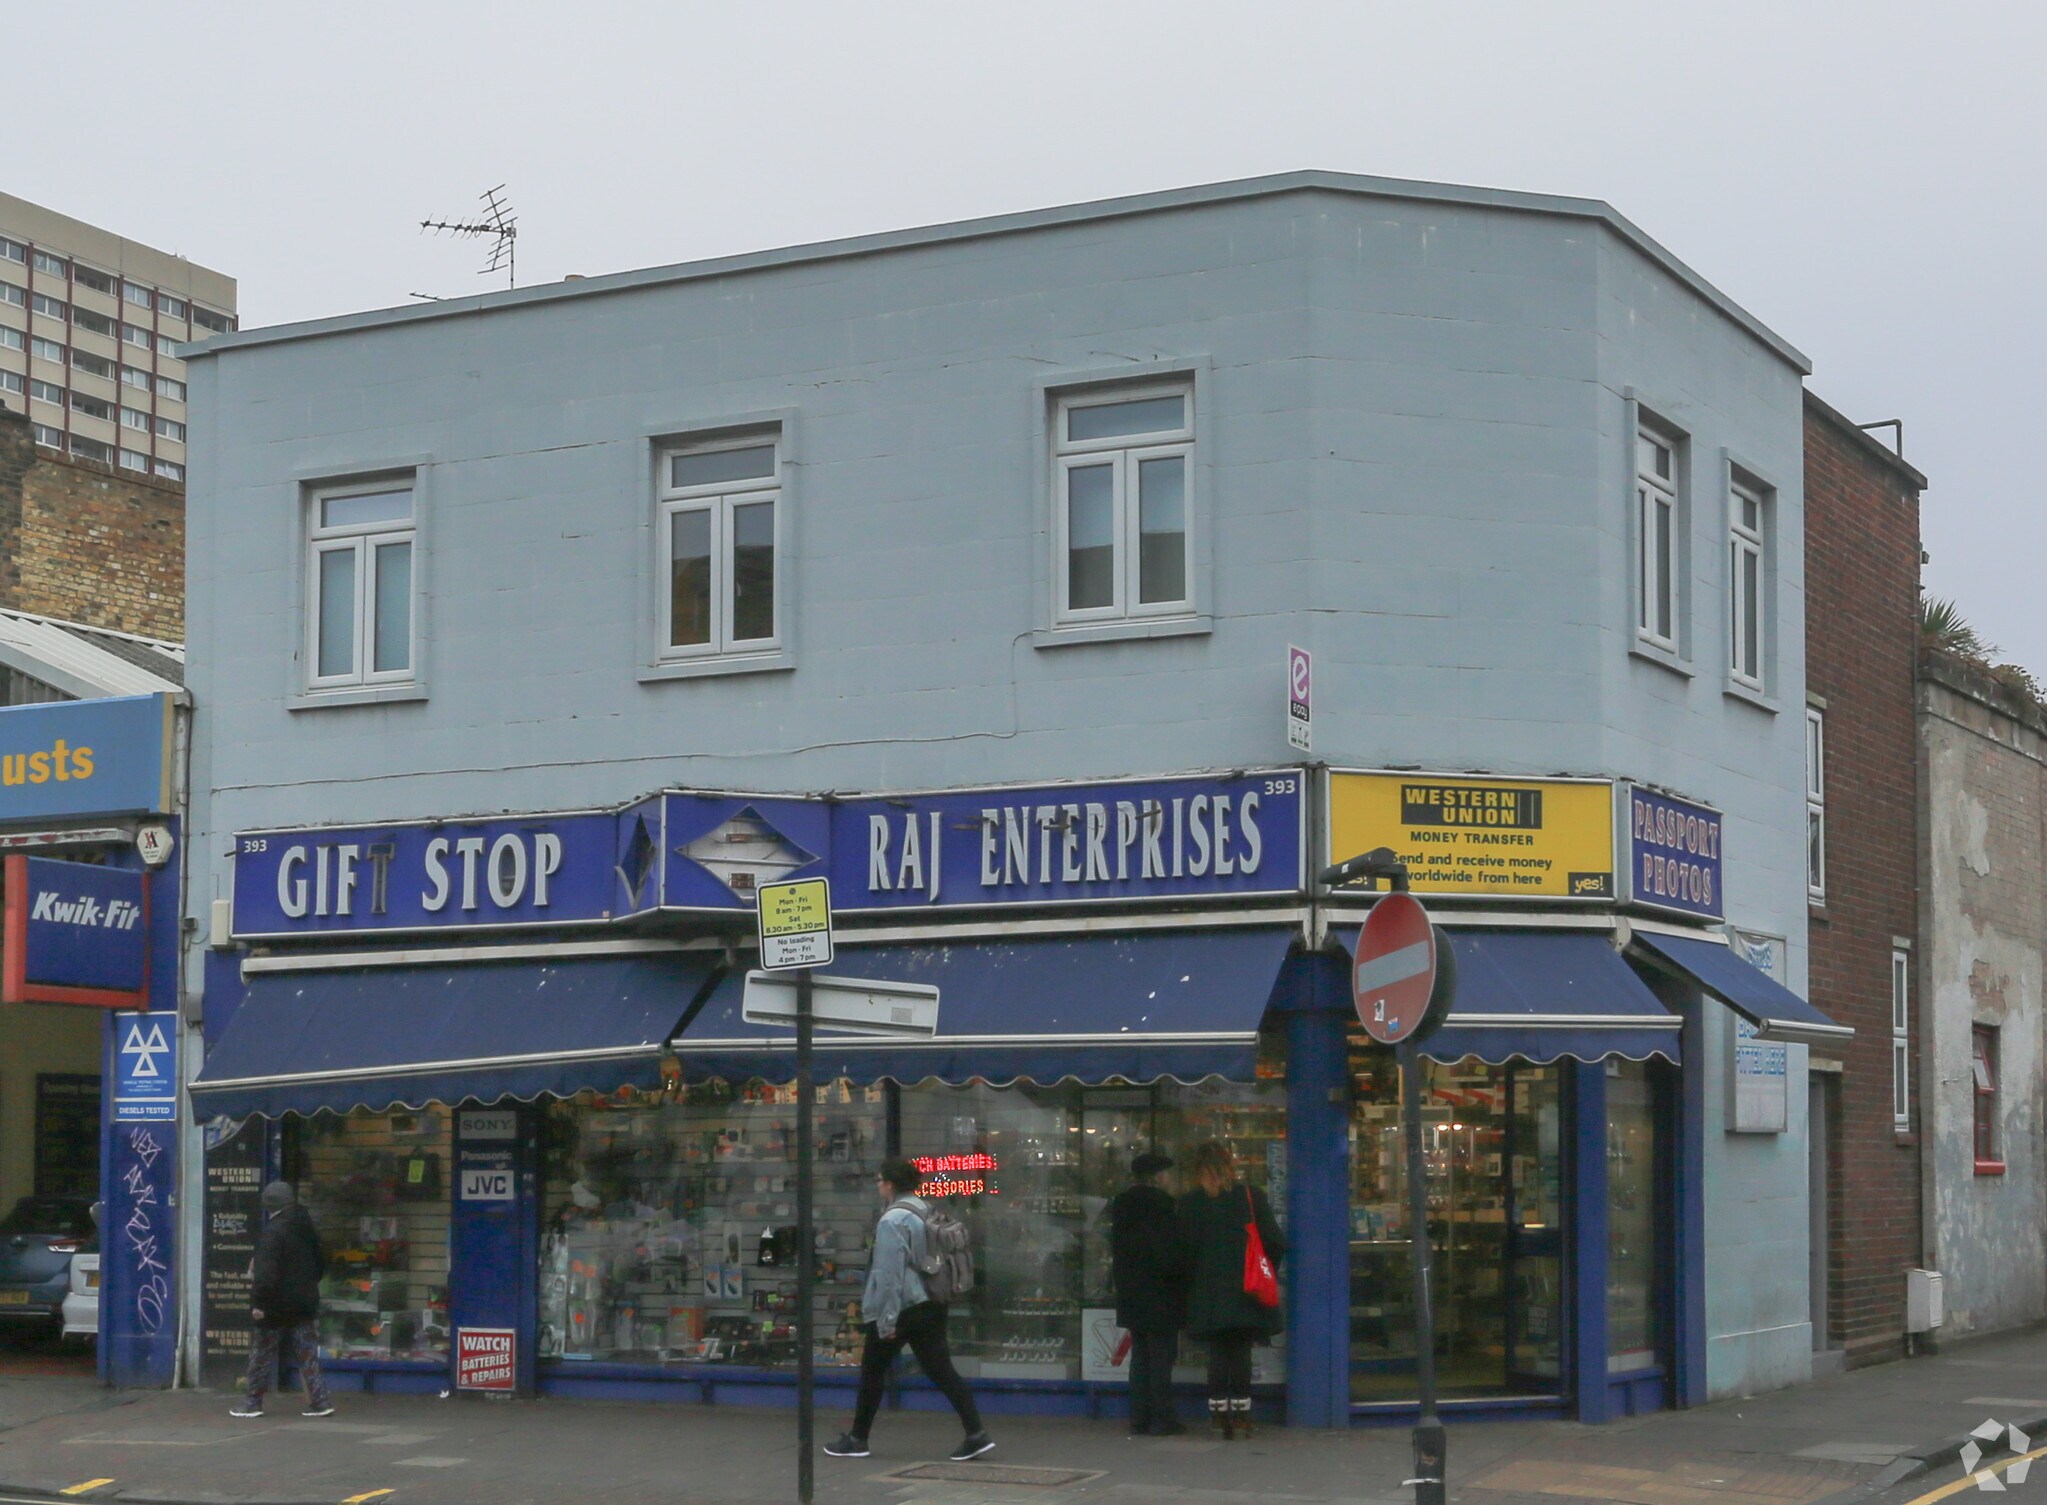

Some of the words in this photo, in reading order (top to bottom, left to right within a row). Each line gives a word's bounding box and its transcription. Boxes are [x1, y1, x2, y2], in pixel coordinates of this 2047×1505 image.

[1292, 702, 1308, 720] epay
[2, 738, 95, 787] usts
[1264, 779, 1296, 796] 393
[1405, 787, 1516, 809] WESTERN
[1442, 807, 1516, 825] UNION
[1633, 797, 1719, 860] PASSPORT
[243, 839, 268, 854] 393
[868, 810, 942, 902] RAJ
[980, 791, 1263, 886] ENTERPRISES
[1410, 831, 1459, 844] MONEY
[1464, 832, 1534, 846] TRANSFER
[1427, 852, 1453, 866] and
[1456, 854, 1506, 867] receive
[1508, 857, 1553, 871] money
[277, 842, 397, 918] GIFT
[421, 833, 563, 912] STOP
[1478, 870, 1510, 884] from
[1513, 873, 1543, 885] here
[1574, 875, 1604, 893] yes!
[1643, 852, 1713, 907] PHOTOS
[798, 896, 808, 904] Fri
[31, 891, 140, 930] Kwik-Fit
[788, 915, 801, 923] Sat
[789, 936, 815, 944] loading
[146, 1106, 170, 1114] TESTED
[463, 1119, 510, 1131] SONY
[461, 1150, 513, 1161] Panasonic
[936, 1153, 993, 1171] BATTERIES
[208, 1167, 252, 1176] WESTERN
[222, 1175, 252, 1184] UNION
[467, 1175, 507, 1195] JVC
[920, 1179, 984, 1193] CESSORIES
[205, 1330, 249, 1338] WESTERN
[220, 1338, 249, 1346] UNION
[461, 1336, 511, 1352] WATCH
[461, 1353, 511, 1371] BATTERIES
[461, 1373, 469, 1385] &
[471, 1367, 511, 1384] REPAIRS
